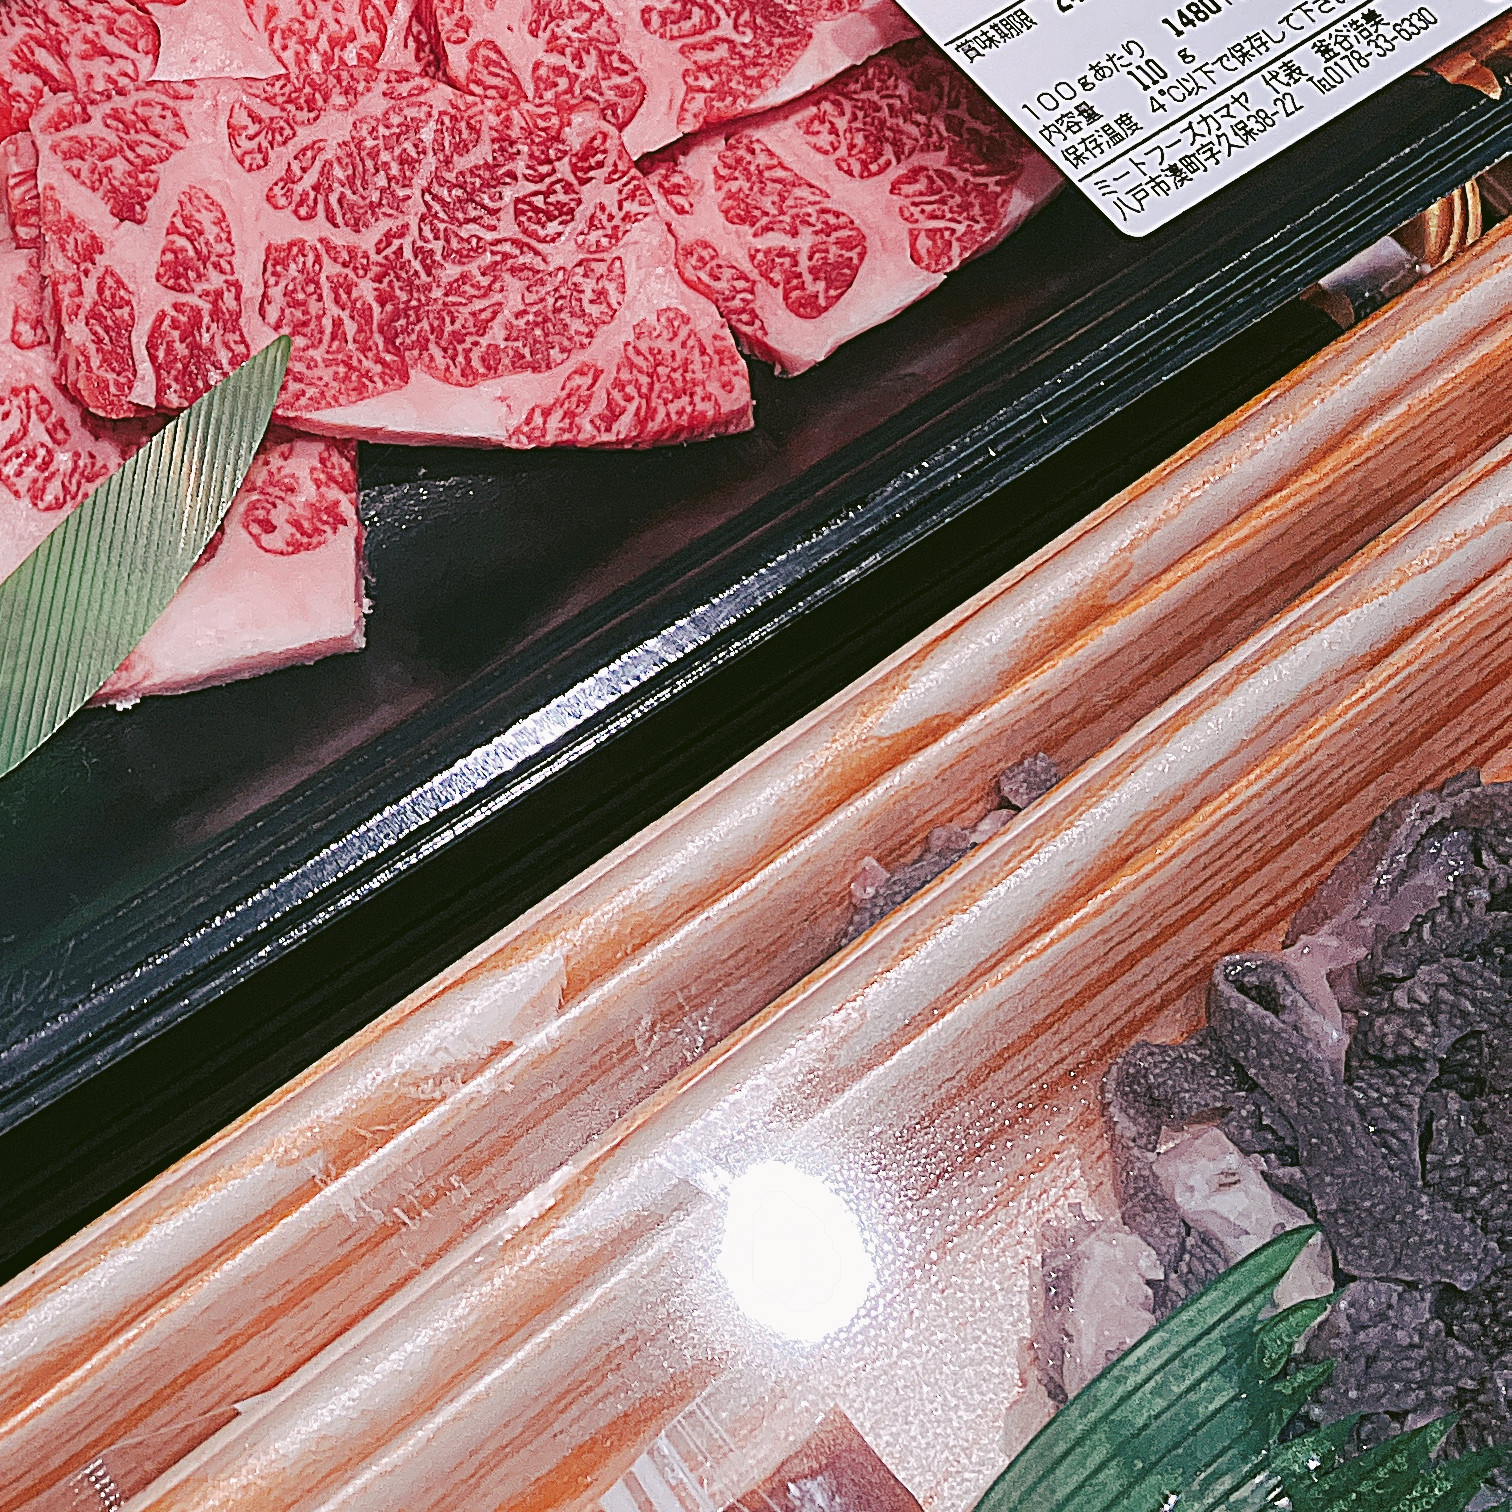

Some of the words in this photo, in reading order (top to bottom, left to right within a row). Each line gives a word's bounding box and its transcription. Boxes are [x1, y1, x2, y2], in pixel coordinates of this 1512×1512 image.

[955, 9, 1037, 64] 賞味期限
[1261, 59, 1308, 94] 代表
[1311, 8, 1390, 65] 釜谷浩美
[1039, 101, 1103, 148] 内容量
[1127, 59, 1167, 91] 110
[1061, 113, 1144, 170] 保存温度
